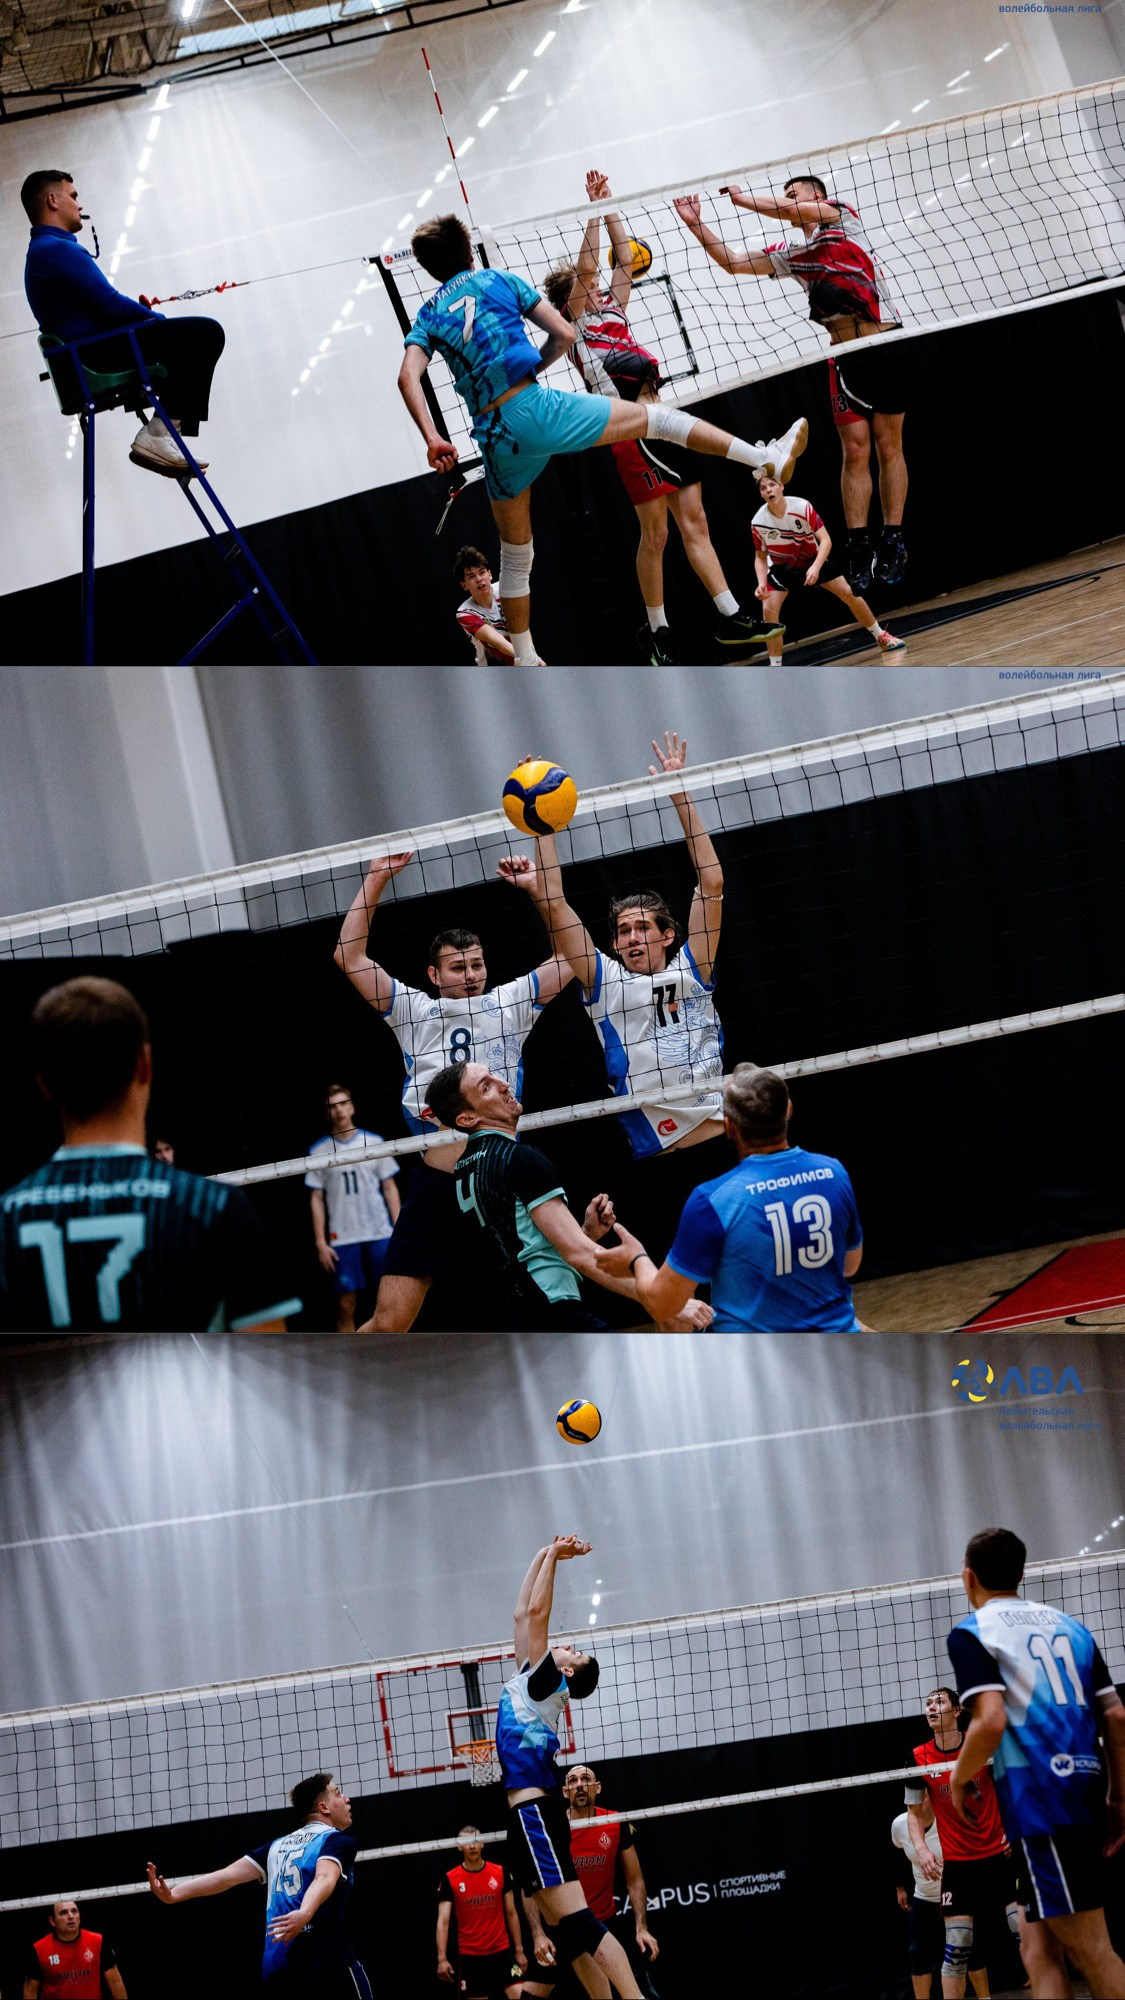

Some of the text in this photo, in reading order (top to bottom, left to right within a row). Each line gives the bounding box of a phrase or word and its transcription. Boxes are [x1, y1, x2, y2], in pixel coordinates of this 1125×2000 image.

[448, 294, 476, 345] 7
[642, 467, 663, 489] 11
[450, 1028, 471, 1066] 8
[343, 1171, 358, 1195] 11
[746, 1168, 834, 1195] ТРОФИМОВ
[456, 1172, 486, 1227] 4
[764, 1194, 834, 1276] 13
[19, 1213, 145, 1327] 17
[1027, 1634, 1088, 1708] 11
[276, 1848, 303, 1897] 15
[719, 1870, 786, 1888] СПОРТИВНЫЕ
[459, 1882, 466, 1892] 3
[721, 1882, 780, 1898] ПЛОЩАДКИ
[942, 1892, 952, 1906] 12
[48, 1954, 60, 1965] 18
[461, 1980, 467, 1990] 3
